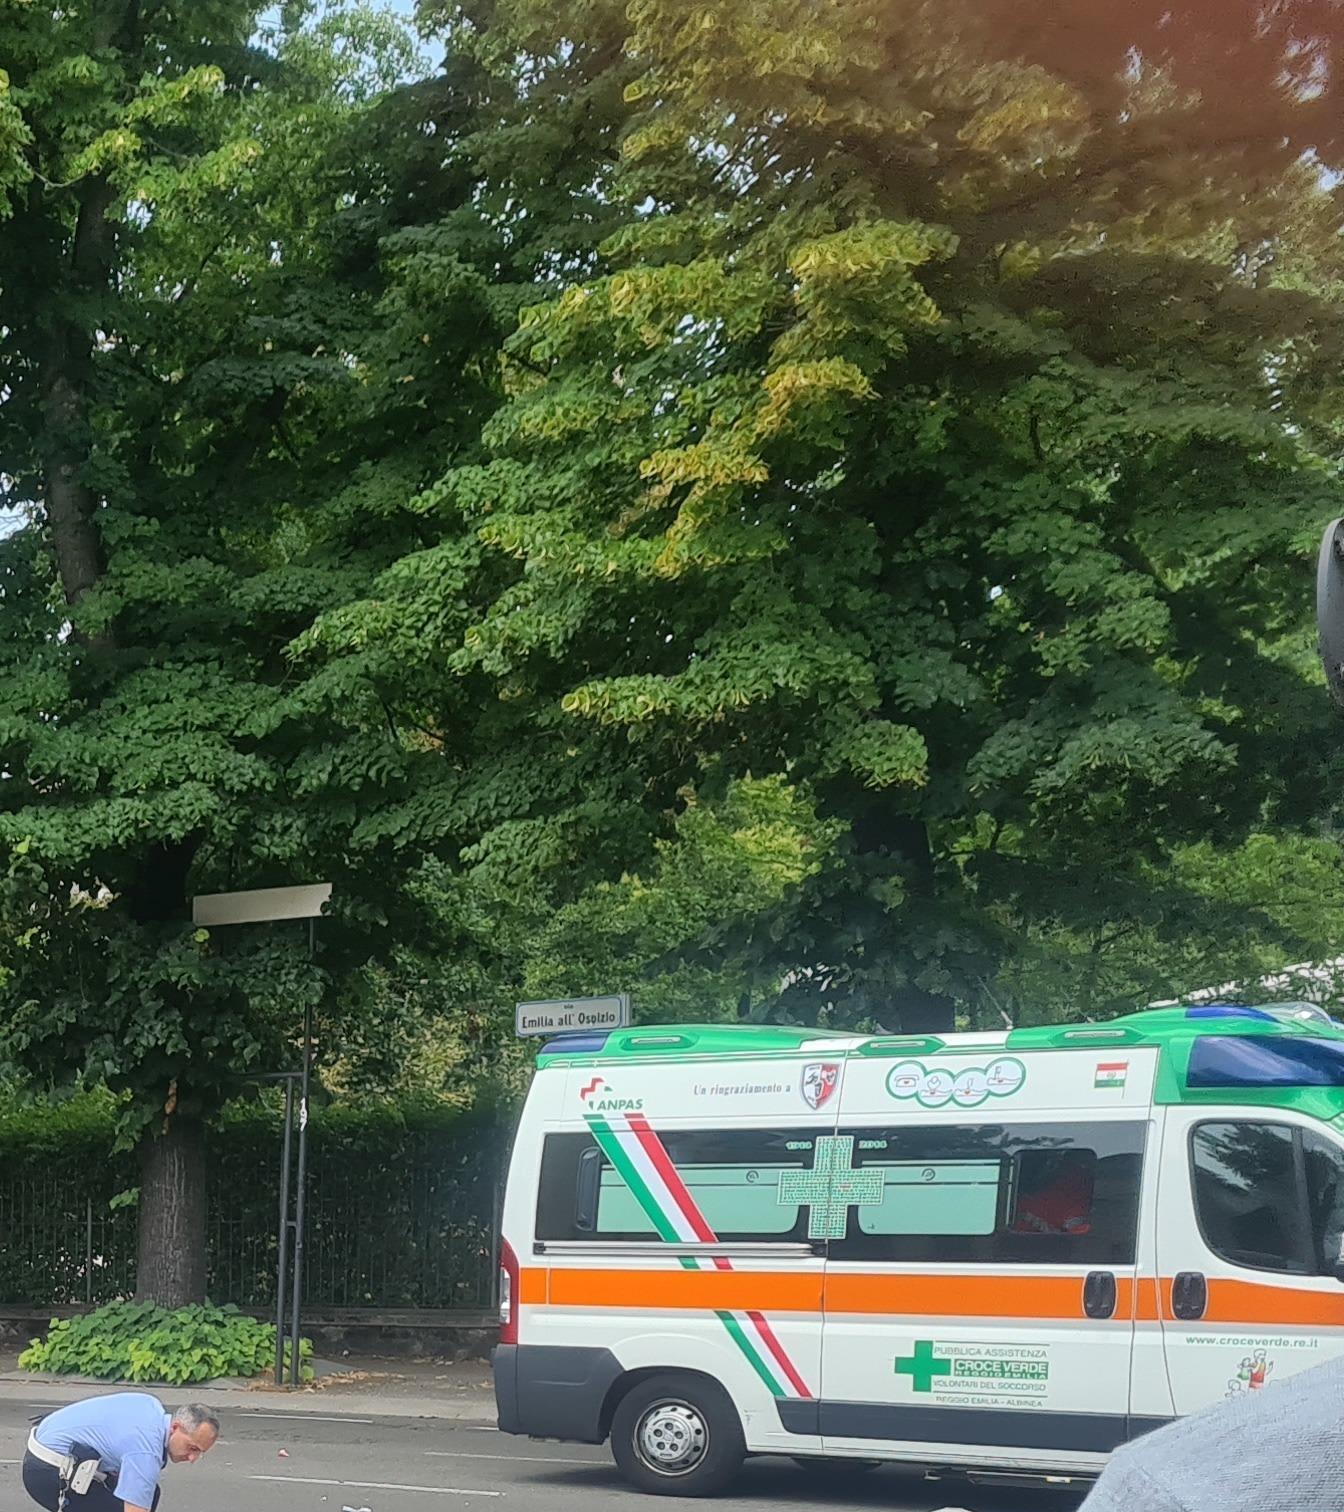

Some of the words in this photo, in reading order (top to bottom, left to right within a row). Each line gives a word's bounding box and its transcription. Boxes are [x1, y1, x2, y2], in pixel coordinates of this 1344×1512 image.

[522, 1016, 553, 1028] Emilia
[578, 1012, 615, 1026] Ospizio
[694, 1084, 706, 1095] Un
[710, 1083, 782, 1096] ringraziamento
[597, 1099, 643, 1111] ANPAS
[1186, 1336, 1318, 1348] www.croceverde.re.it
[934, 1347, 981, 1356] PUBBLICA
[984, 1348, 1047, 1358] ASSISTENZA
[955, 1360, 1001, 1372] CROCE
[1002, 1361, 1047, 1373] VERDE
[934, 1379, 978, 1389] VOLONTARI
[998, 1382, 1046, 1391] SOCCORSO
